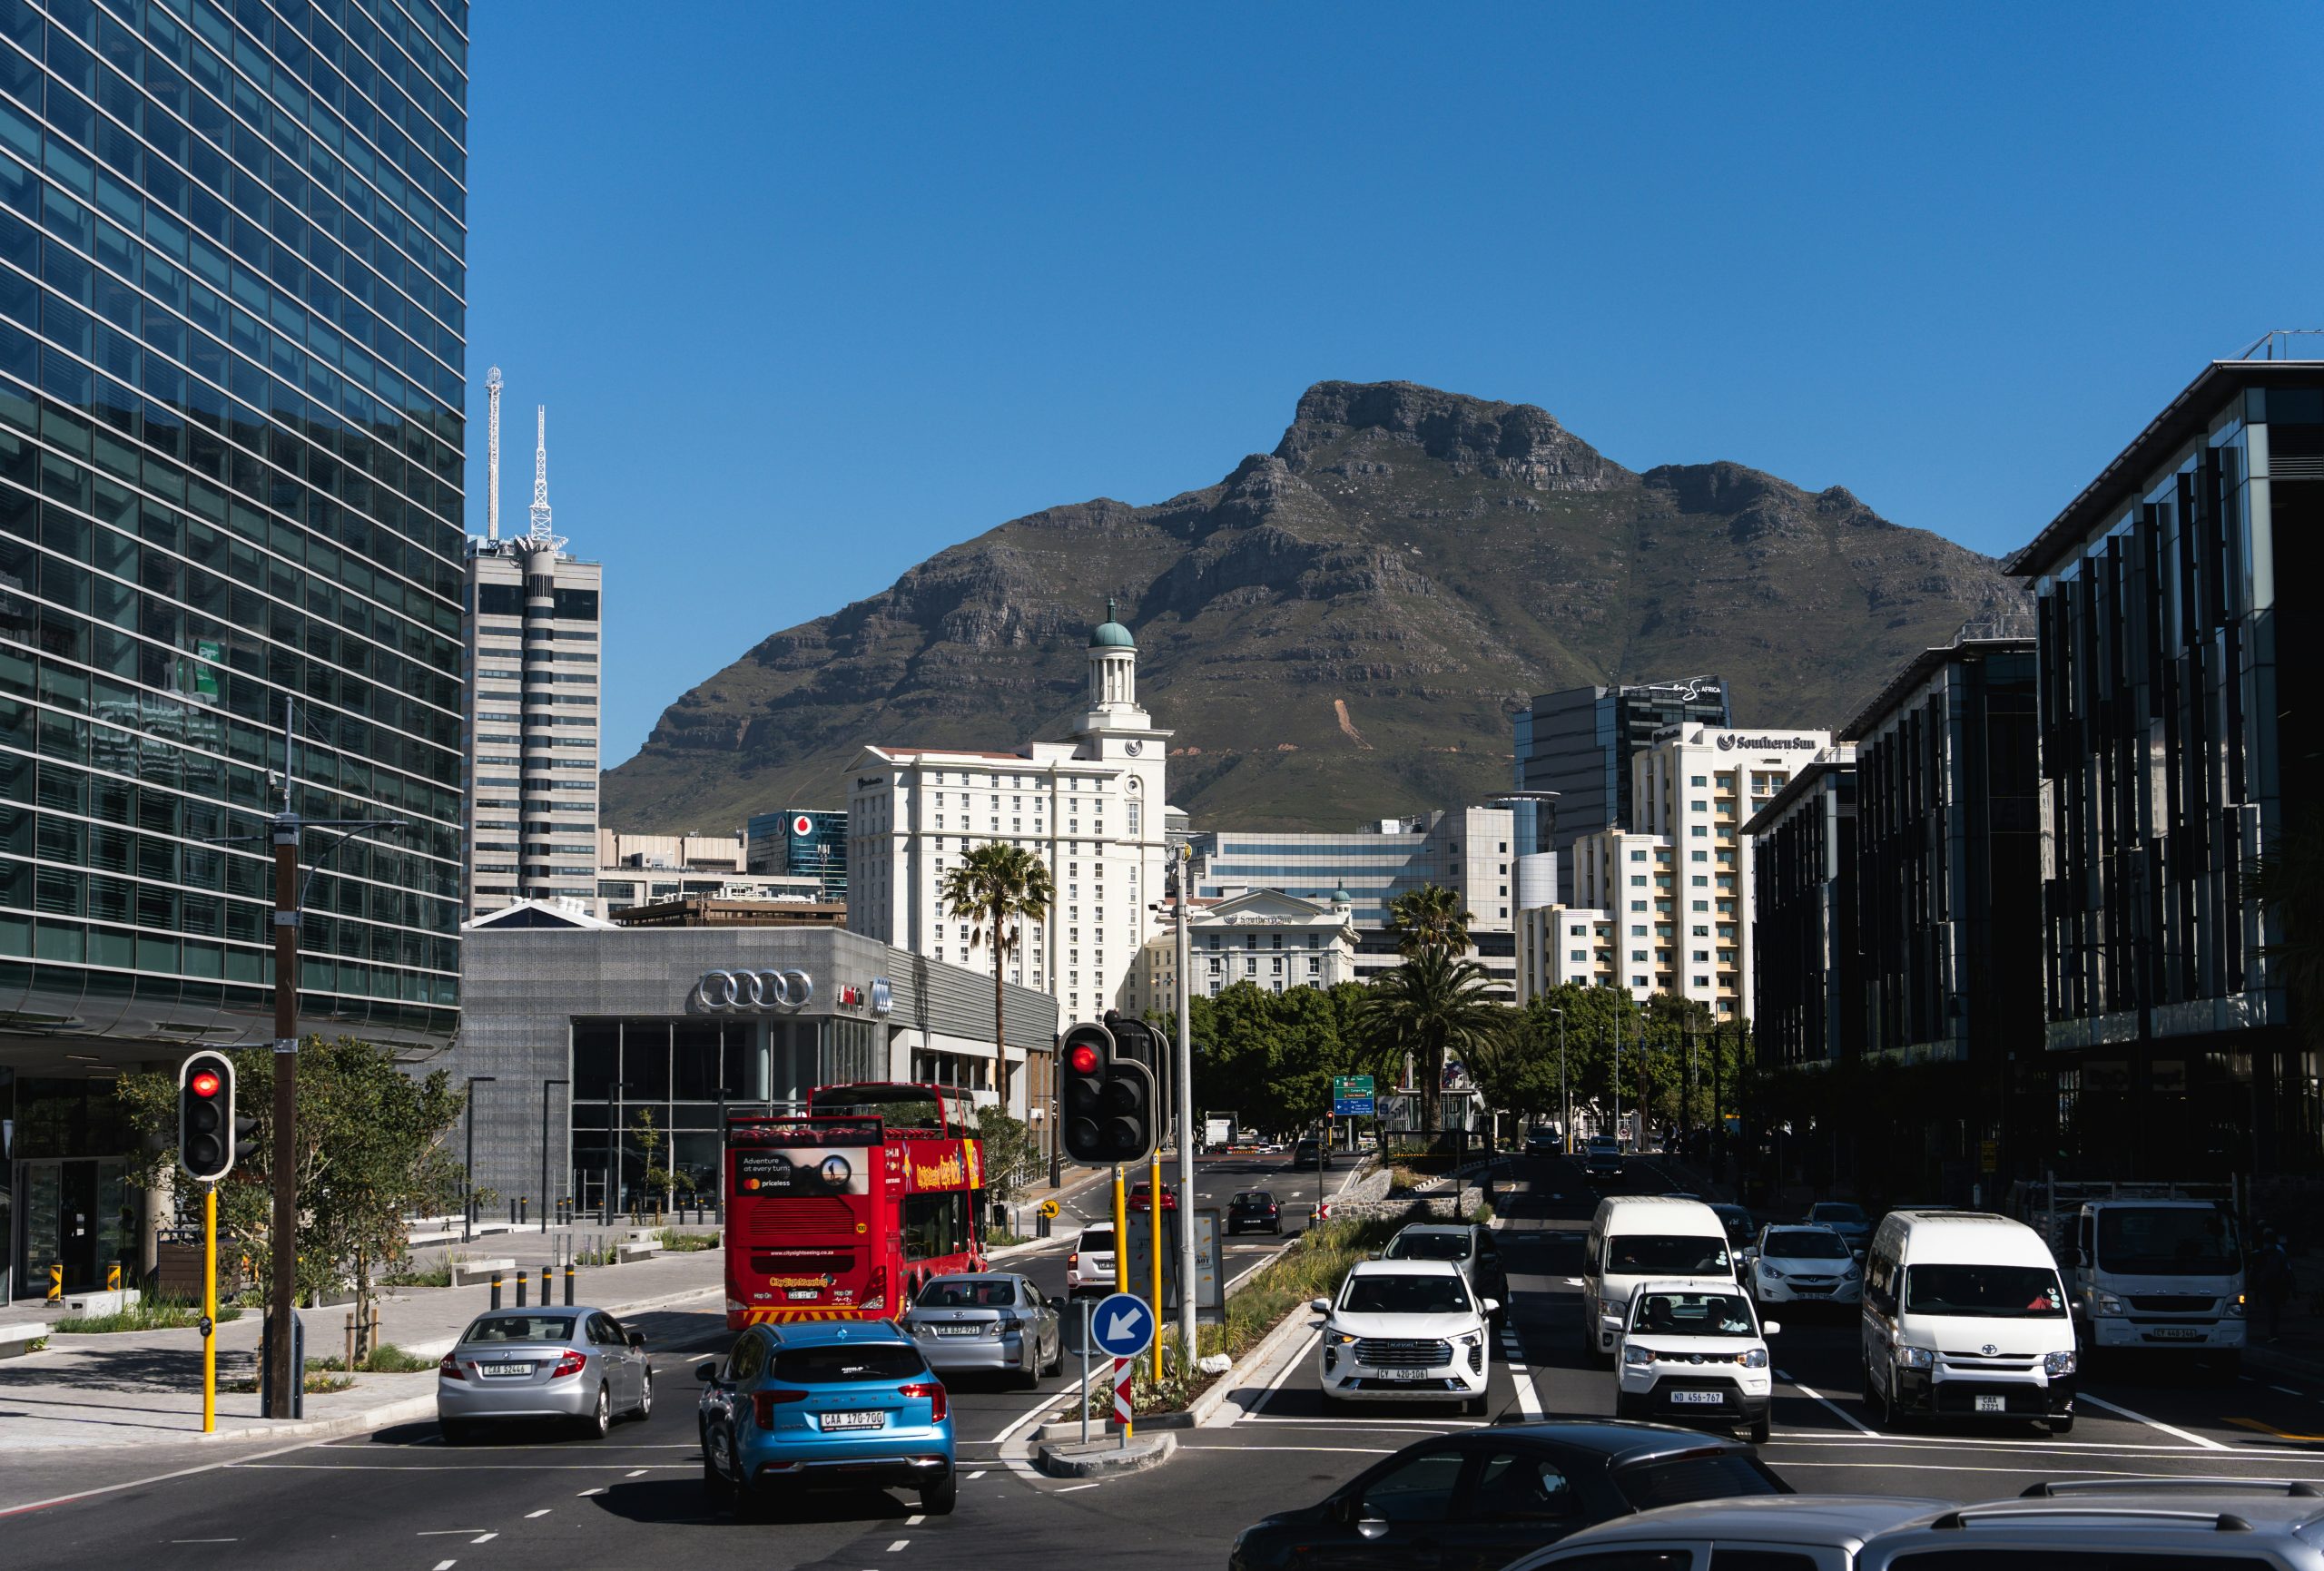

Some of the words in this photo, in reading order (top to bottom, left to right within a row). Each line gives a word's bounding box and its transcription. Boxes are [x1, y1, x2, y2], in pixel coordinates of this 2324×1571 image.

[762, 1180, 791, 1188] priceless
[940, 1326, 948, 1334] CA
[504, 1365, 525, 1373] 52446
[1396, 1370, 1424, 1379] 420-106
[1674, 1392, 1683, 1401] ND
[1689, 1393, 1720, 1402] 456-767
[1983, 1396, 1996, 1404] CAA
[824, 1414, 842, 1426] CAA
[847, 1412, 882, 1424] 170-700
